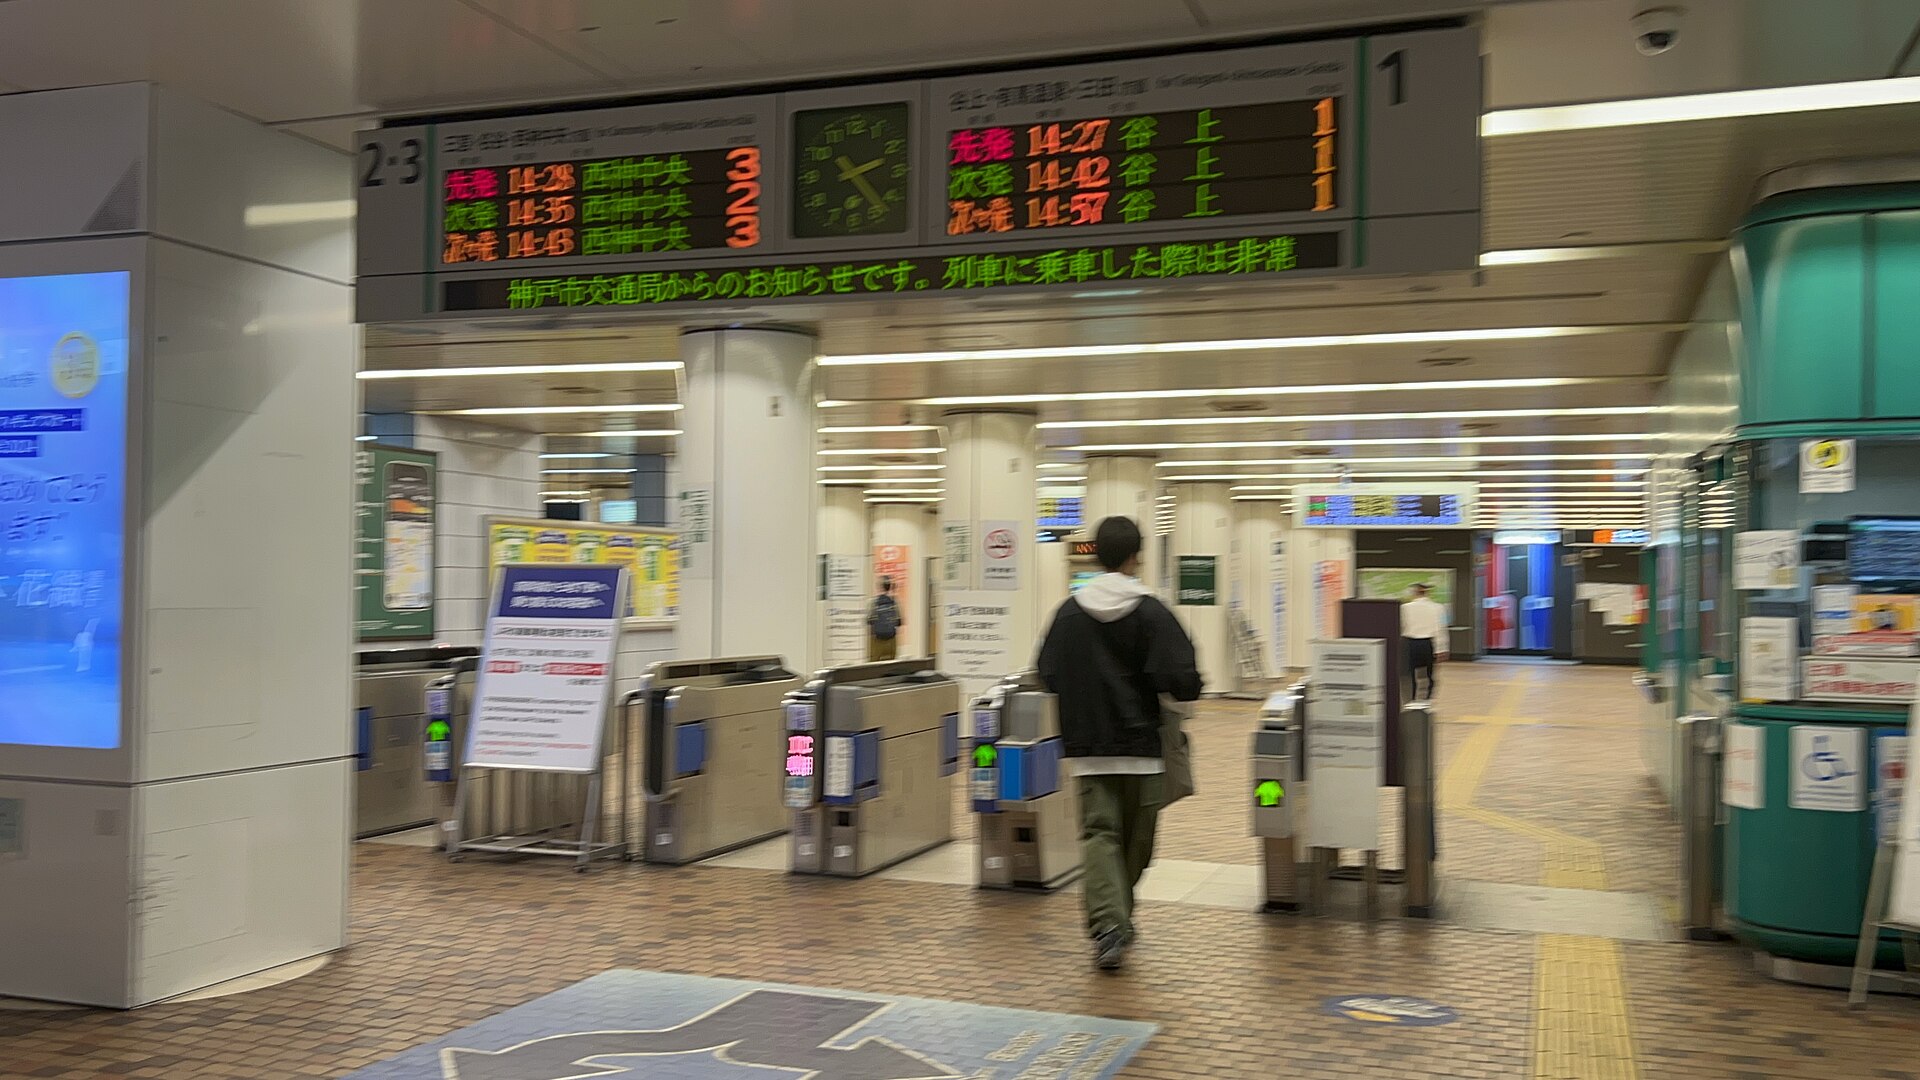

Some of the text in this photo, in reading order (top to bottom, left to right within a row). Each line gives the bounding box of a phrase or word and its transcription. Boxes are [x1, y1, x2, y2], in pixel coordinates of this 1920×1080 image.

[1377, 48, 1408, 106] 1
[949, 126, 1015, 165] 先発
[1026, 119, 1111, 158] 14:27
[1312, 97, 1338, 136] 1
[507, 163, 576, 195] 14:28
[582, 154, 693, 191] 西神中央
[725, 146, 762, 182] 3
[948, 162, 1015, 199] 次発
[1025, 155, 1111, 193] 14:42
[1312, 134, 1338, 174] 1
[506, 195, 576, 227] 14:35
[582, 187, 692, 224] 西神中央
[725, 180, 762, 216] 2
[1025, 191, 1110, 228] 14:57
[1311, 173, 1337, 212] 1
[725, 214, 761, 248] 3
